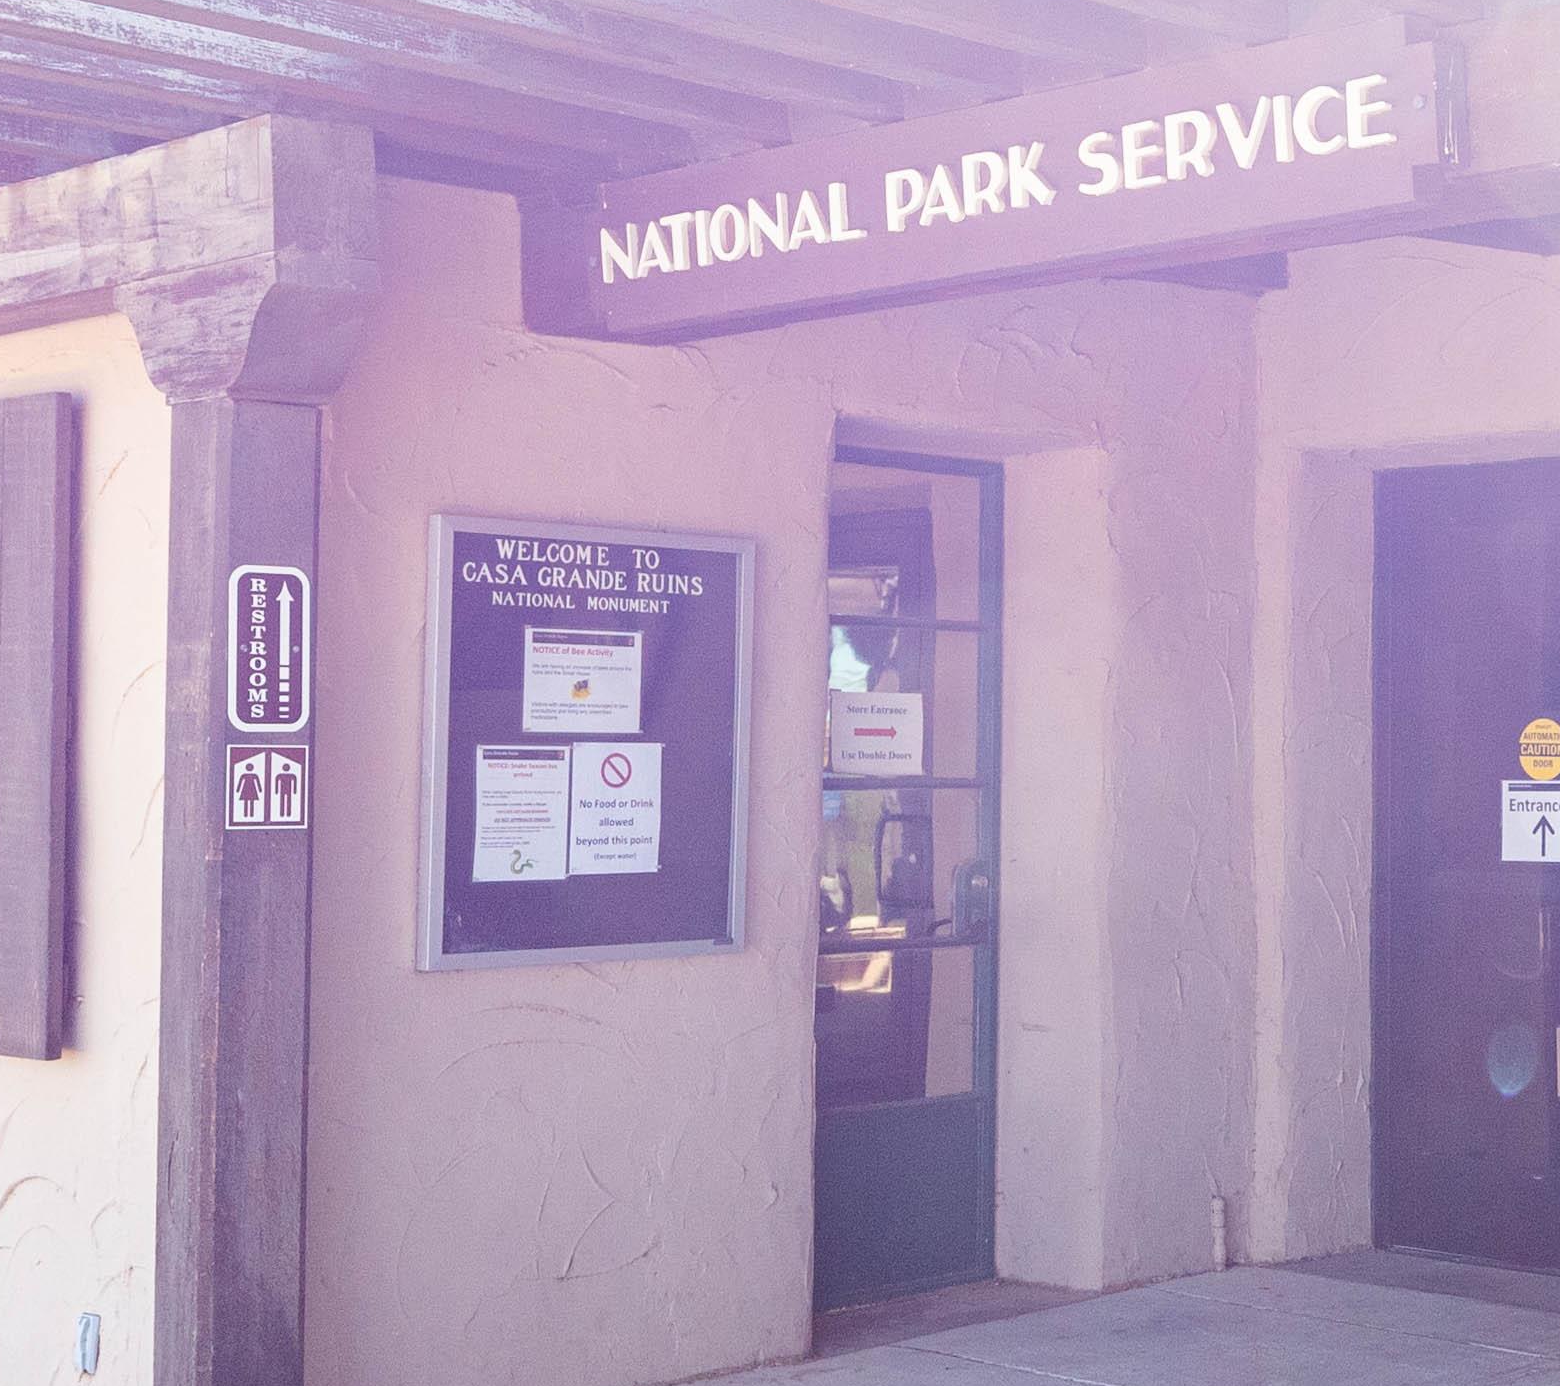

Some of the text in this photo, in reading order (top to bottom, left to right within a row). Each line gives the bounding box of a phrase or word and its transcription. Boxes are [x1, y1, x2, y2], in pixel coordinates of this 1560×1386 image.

[600, 73, 1396, 284] NATIONAL PARK SERVICE
[495, 538, 660, 569] WELCOME TO
[462, 561, 704, 596] CASA GRANDE RUINS
[492, 590, 670, 614] NATIONAL MONUMENT
[247, 578, 268, 719] RESTROOMS
[532, 646, 560, 655] NOTICE
[586, 648, 614, 658] Activity
[888, 751, 913, 760] Doors
[1533, 759, 1553, 768] DOOR
[579, 798, 654, 809] No Food or Drink
[599, 817, 634, 827] allowed
[575, 835, 653, 847] beyond this point
